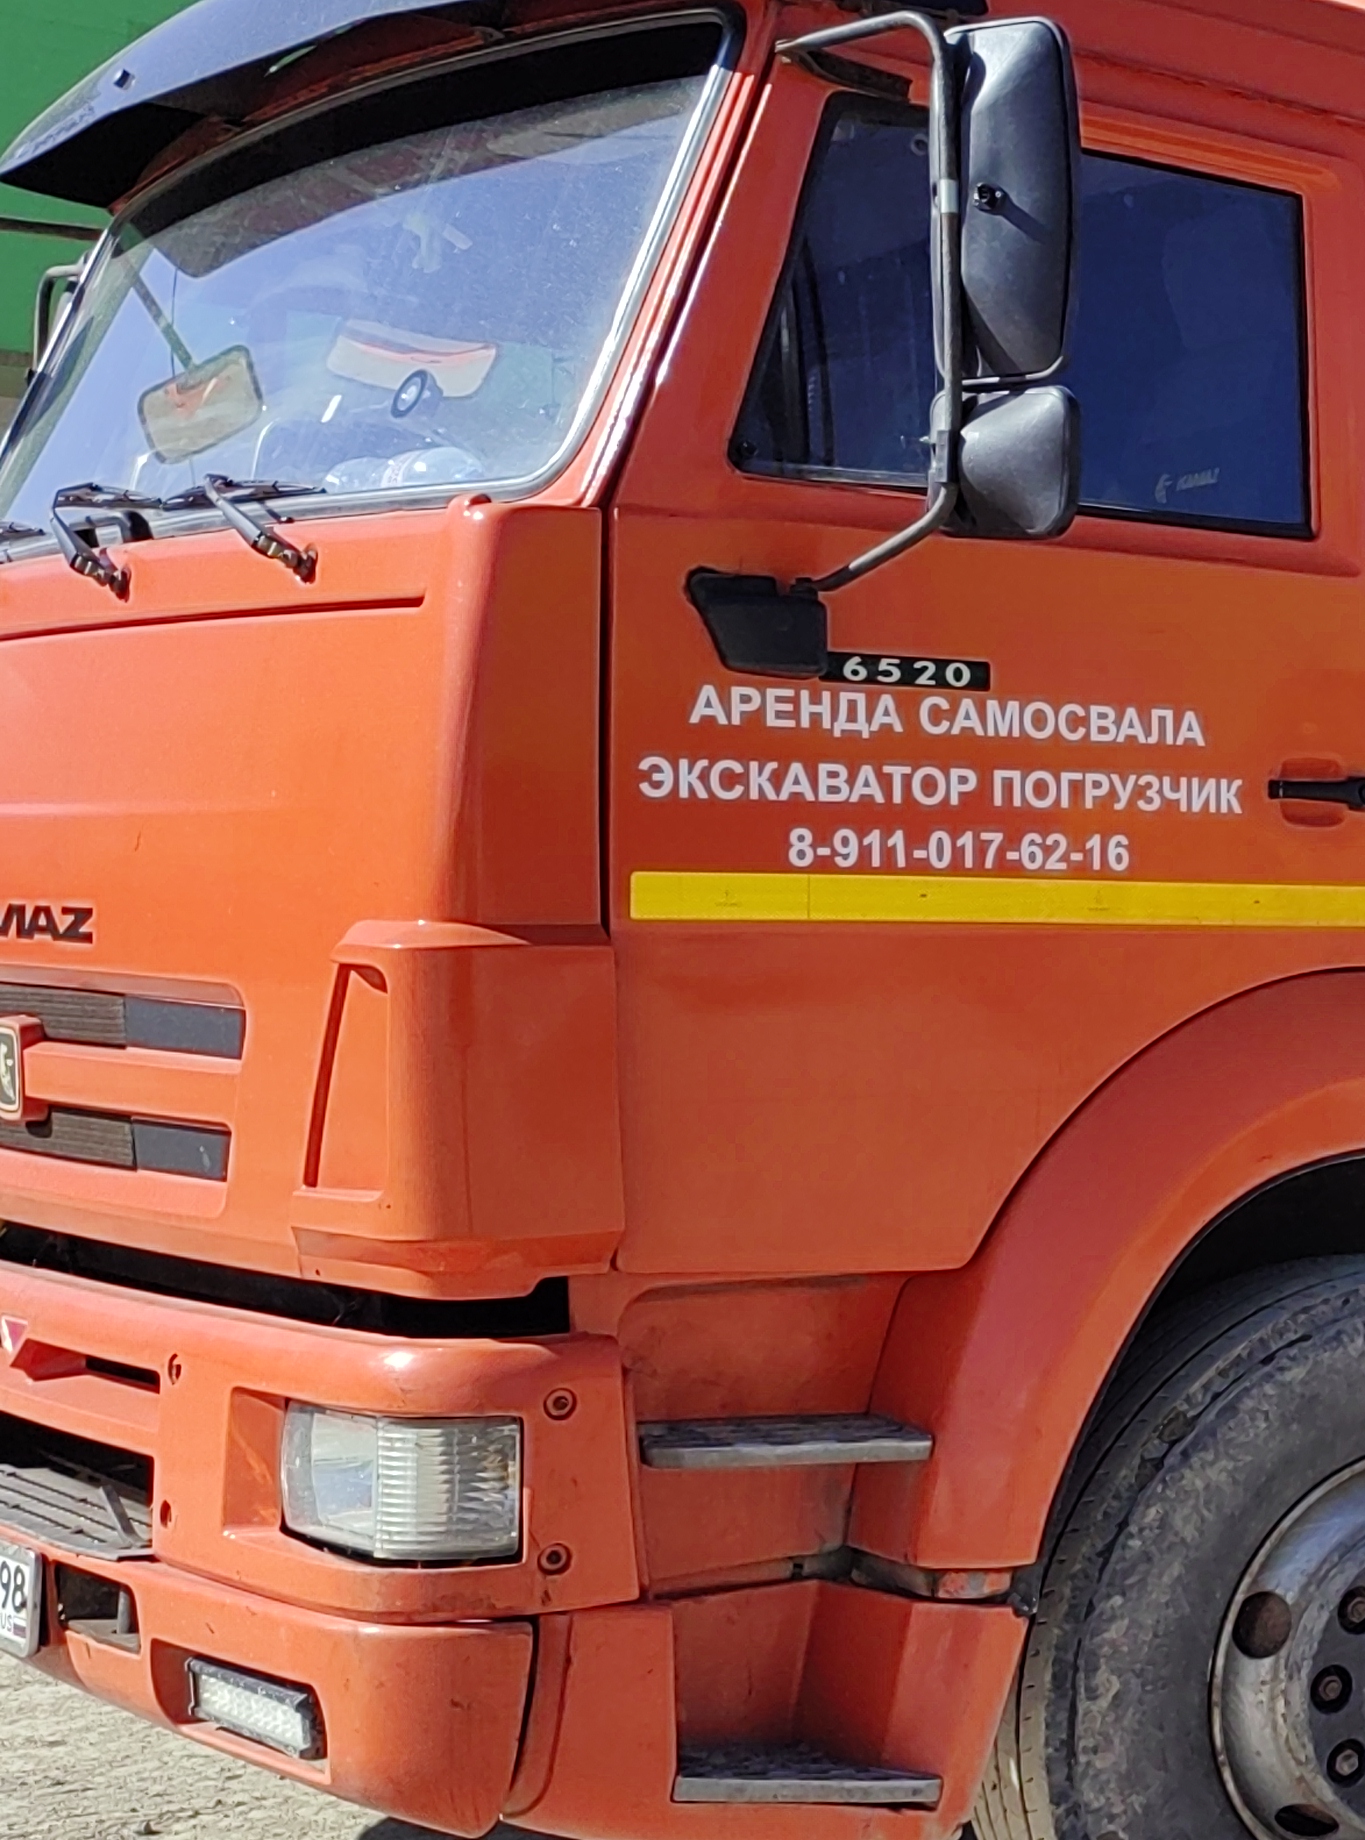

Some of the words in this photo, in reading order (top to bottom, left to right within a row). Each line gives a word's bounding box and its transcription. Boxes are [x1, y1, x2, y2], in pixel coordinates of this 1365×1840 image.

[842, 655, 972, 688] 6520
[688, 684, 905, 739] АРЕНДА
[919, 695, 1207, 748] САМОСВАЛА
[637, 756, 979, 807] ЭКСКАВАТОР
[992, 768, 1244, 815] ПОГРУЗЧИК
[787, 826, 1131, 873] 8-911-017-62-16
